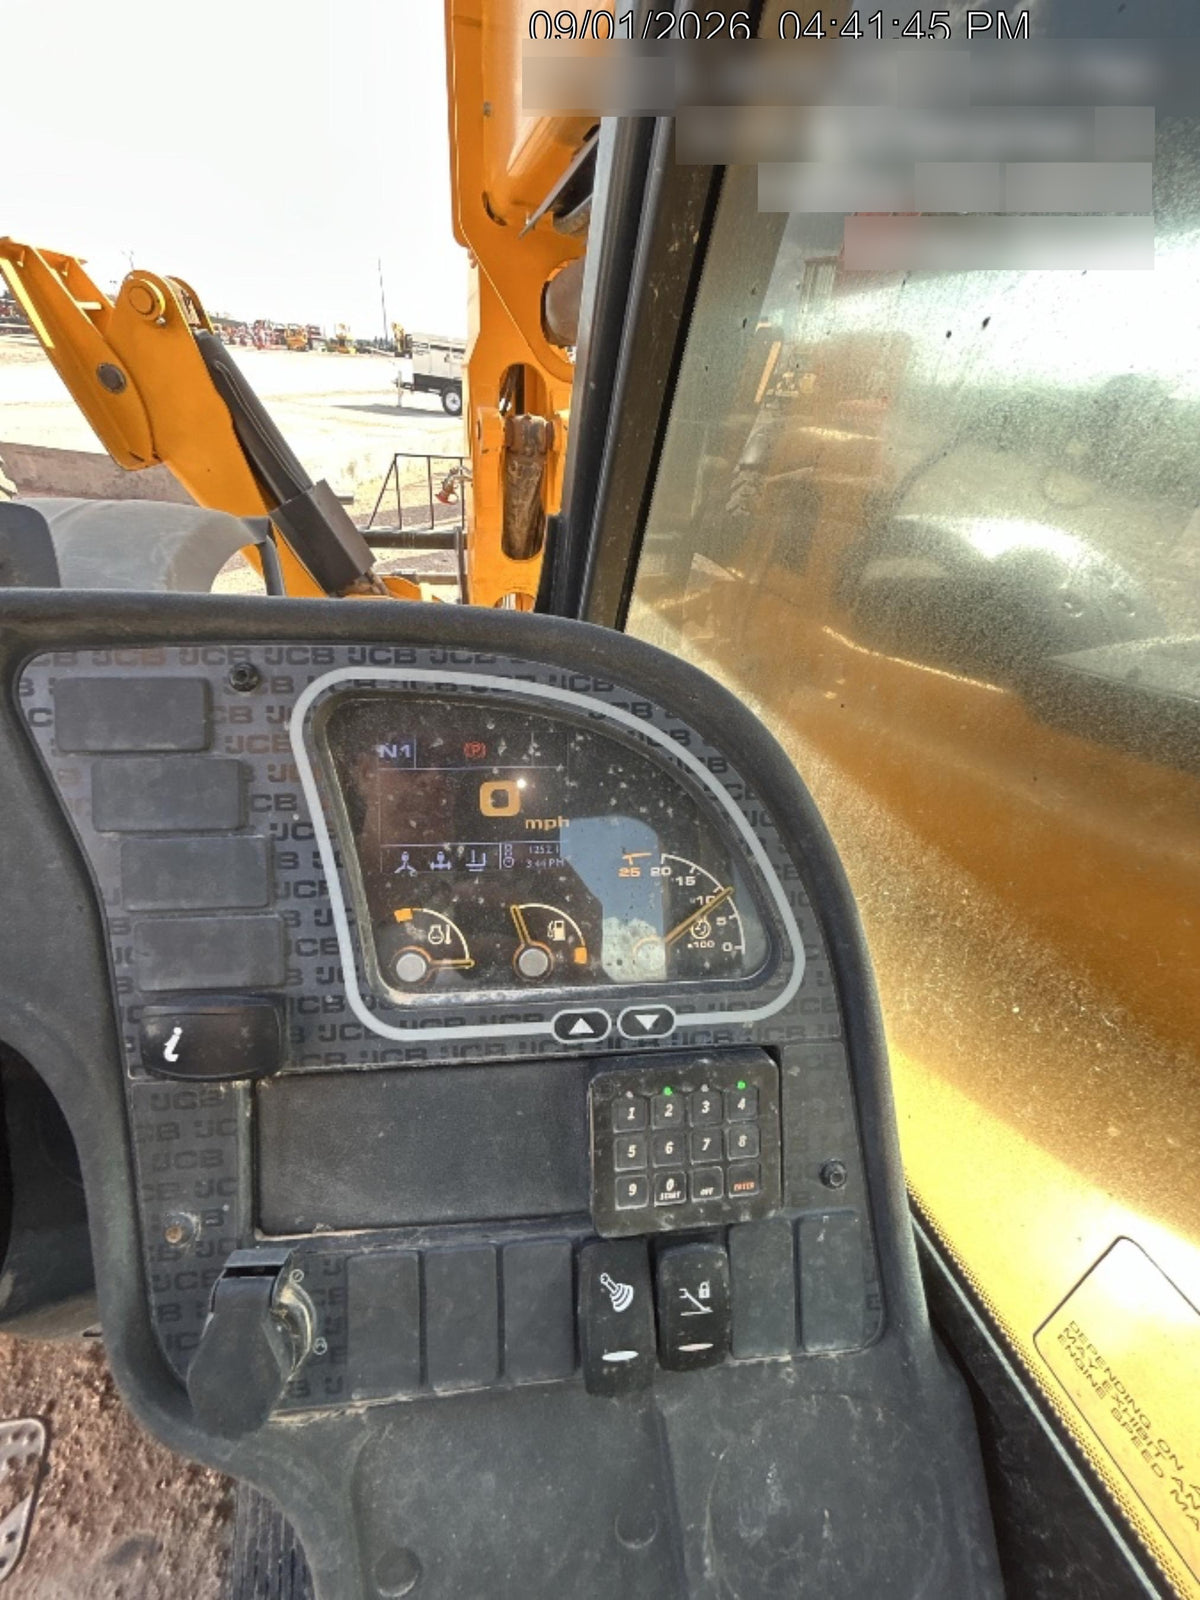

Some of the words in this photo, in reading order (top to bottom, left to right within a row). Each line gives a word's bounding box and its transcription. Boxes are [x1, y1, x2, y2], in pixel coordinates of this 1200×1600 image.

[179, 648, 251, 665] JCB
[265, 647, 335, 665] JCB
[348, 647, 417, 664] JCB
[380, 743, 412, 758] N1
[251, 793, 297, 812] CB
[480, 780, 521, 817] 0
[525, 816, 570, 831] mph
[618, 867, 641, 877] 25
[651, 866, 672, 876] 20
[676, 876, 696, 887] 15
[716, 917, 727, 926] 5
[722, 942, 733, 952] 0
[664, 1104, 673, 1117] 2
[702, 1101, 711, 1114] 3
[737, 1098, 746, 1111] 4
[627, 1107, 636, 1120] 1
[665, 1141, 675, 1154] 6
[702, 1137, 712, 1151] 7
[738, 1135, 747, 1147] 8
[628, 1144, 637, 1158] 5
[629, 1183, 637, 1196] 9
[666, 1178, 675, 1191] 0
[1063, 1327, 1098, 1369] MAY
[1103, 1381, 1167, 1460] EXHIBIT
[1069, 1320, 1152, 1430] DEPENDING
[1157, 1438, 1184, 1471] ON
[1057, 1334, 1105, 1400] ENGINE
[1110, 1407, 1165, 1479] SPEED
